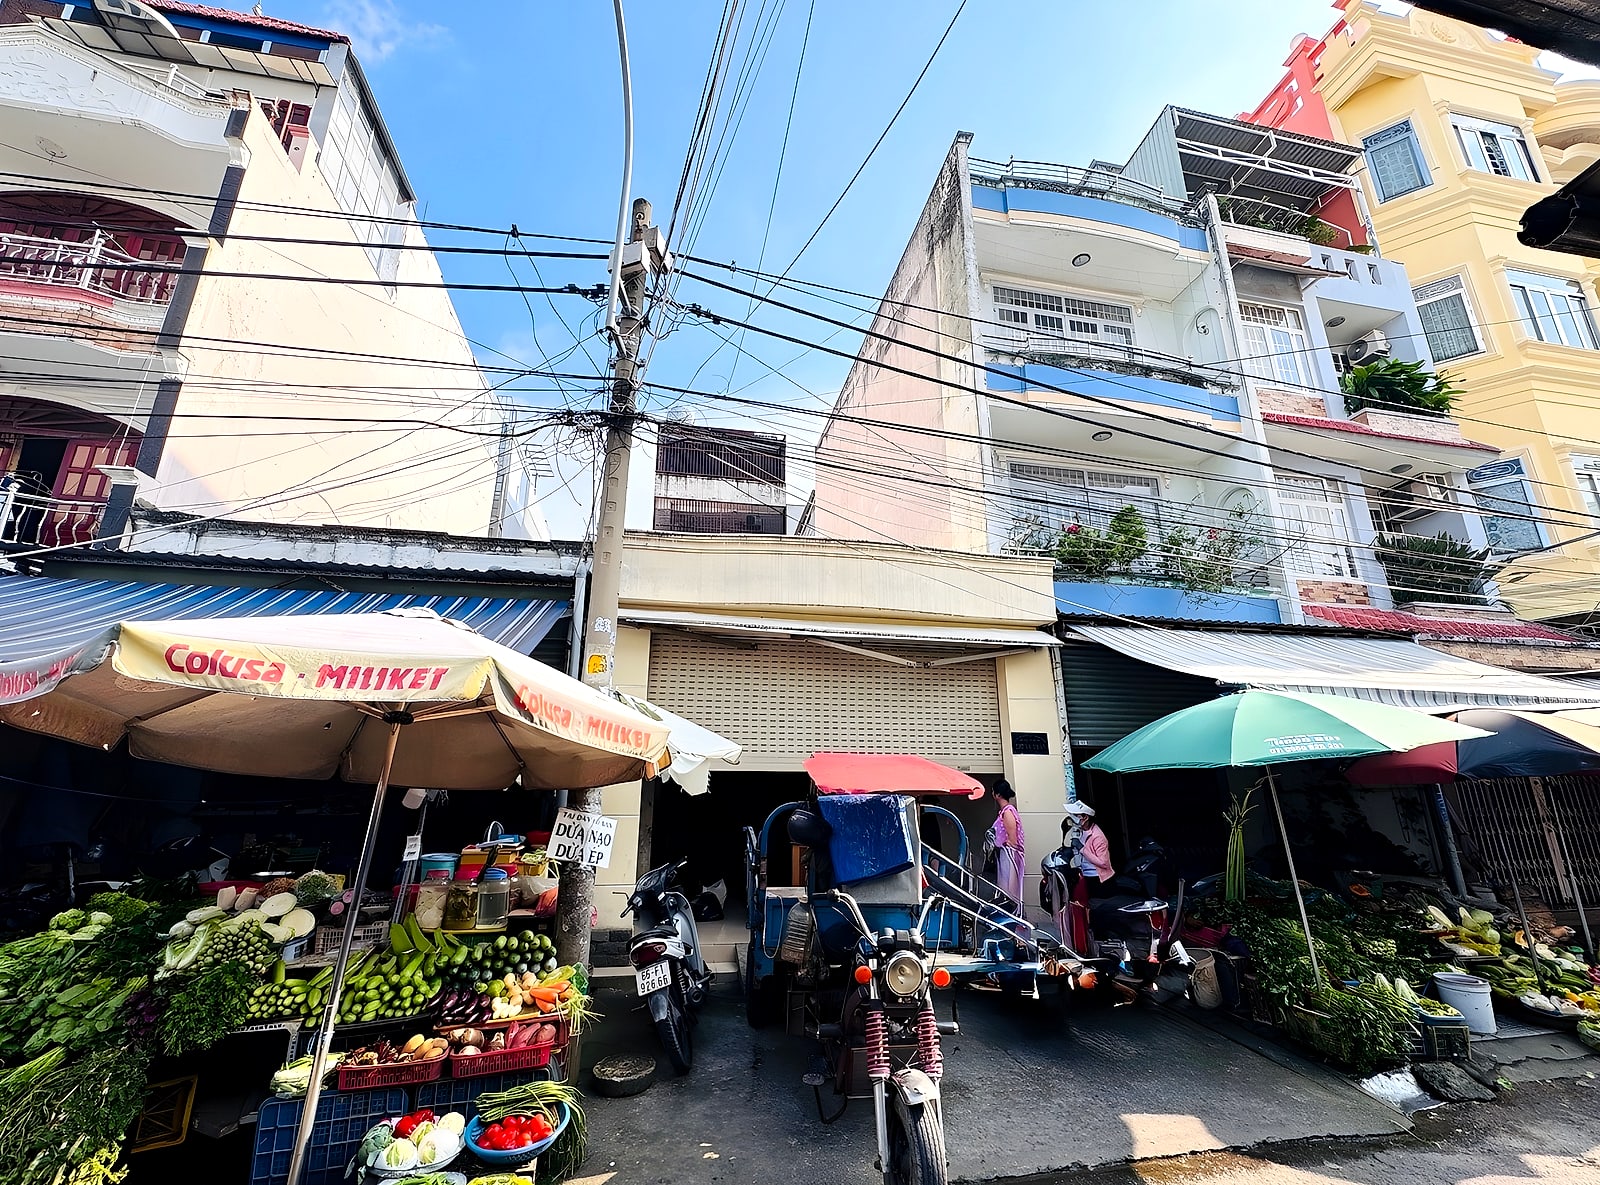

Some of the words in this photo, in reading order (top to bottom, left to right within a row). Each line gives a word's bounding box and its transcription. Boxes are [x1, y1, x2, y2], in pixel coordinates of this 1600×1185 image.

[164, 643, 286, 683] Colusa
[315, 664, 449, 690] MILIKET
[514, 684, 572, 729] Colusa
